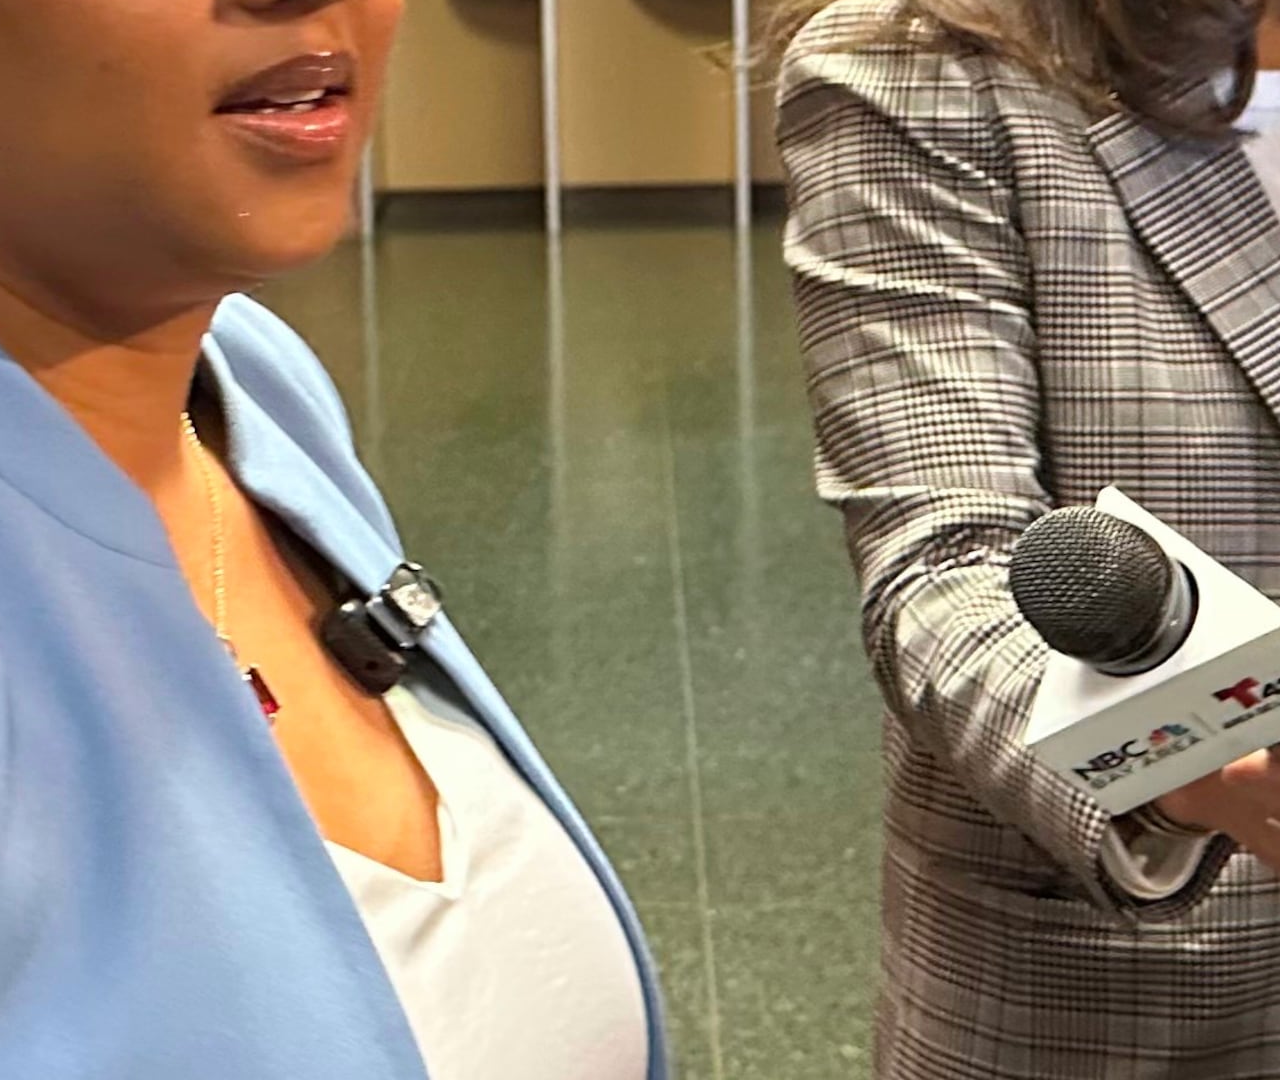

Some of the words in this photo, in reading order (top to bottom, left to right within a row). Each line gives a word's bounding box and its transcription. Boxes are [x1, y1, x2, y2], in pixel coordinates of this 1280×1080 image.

[1072, 738, 1149, 781] NBC
[1089, 764, 1134, 790] BAY
[1141, 735, 1204, 768] AREA
